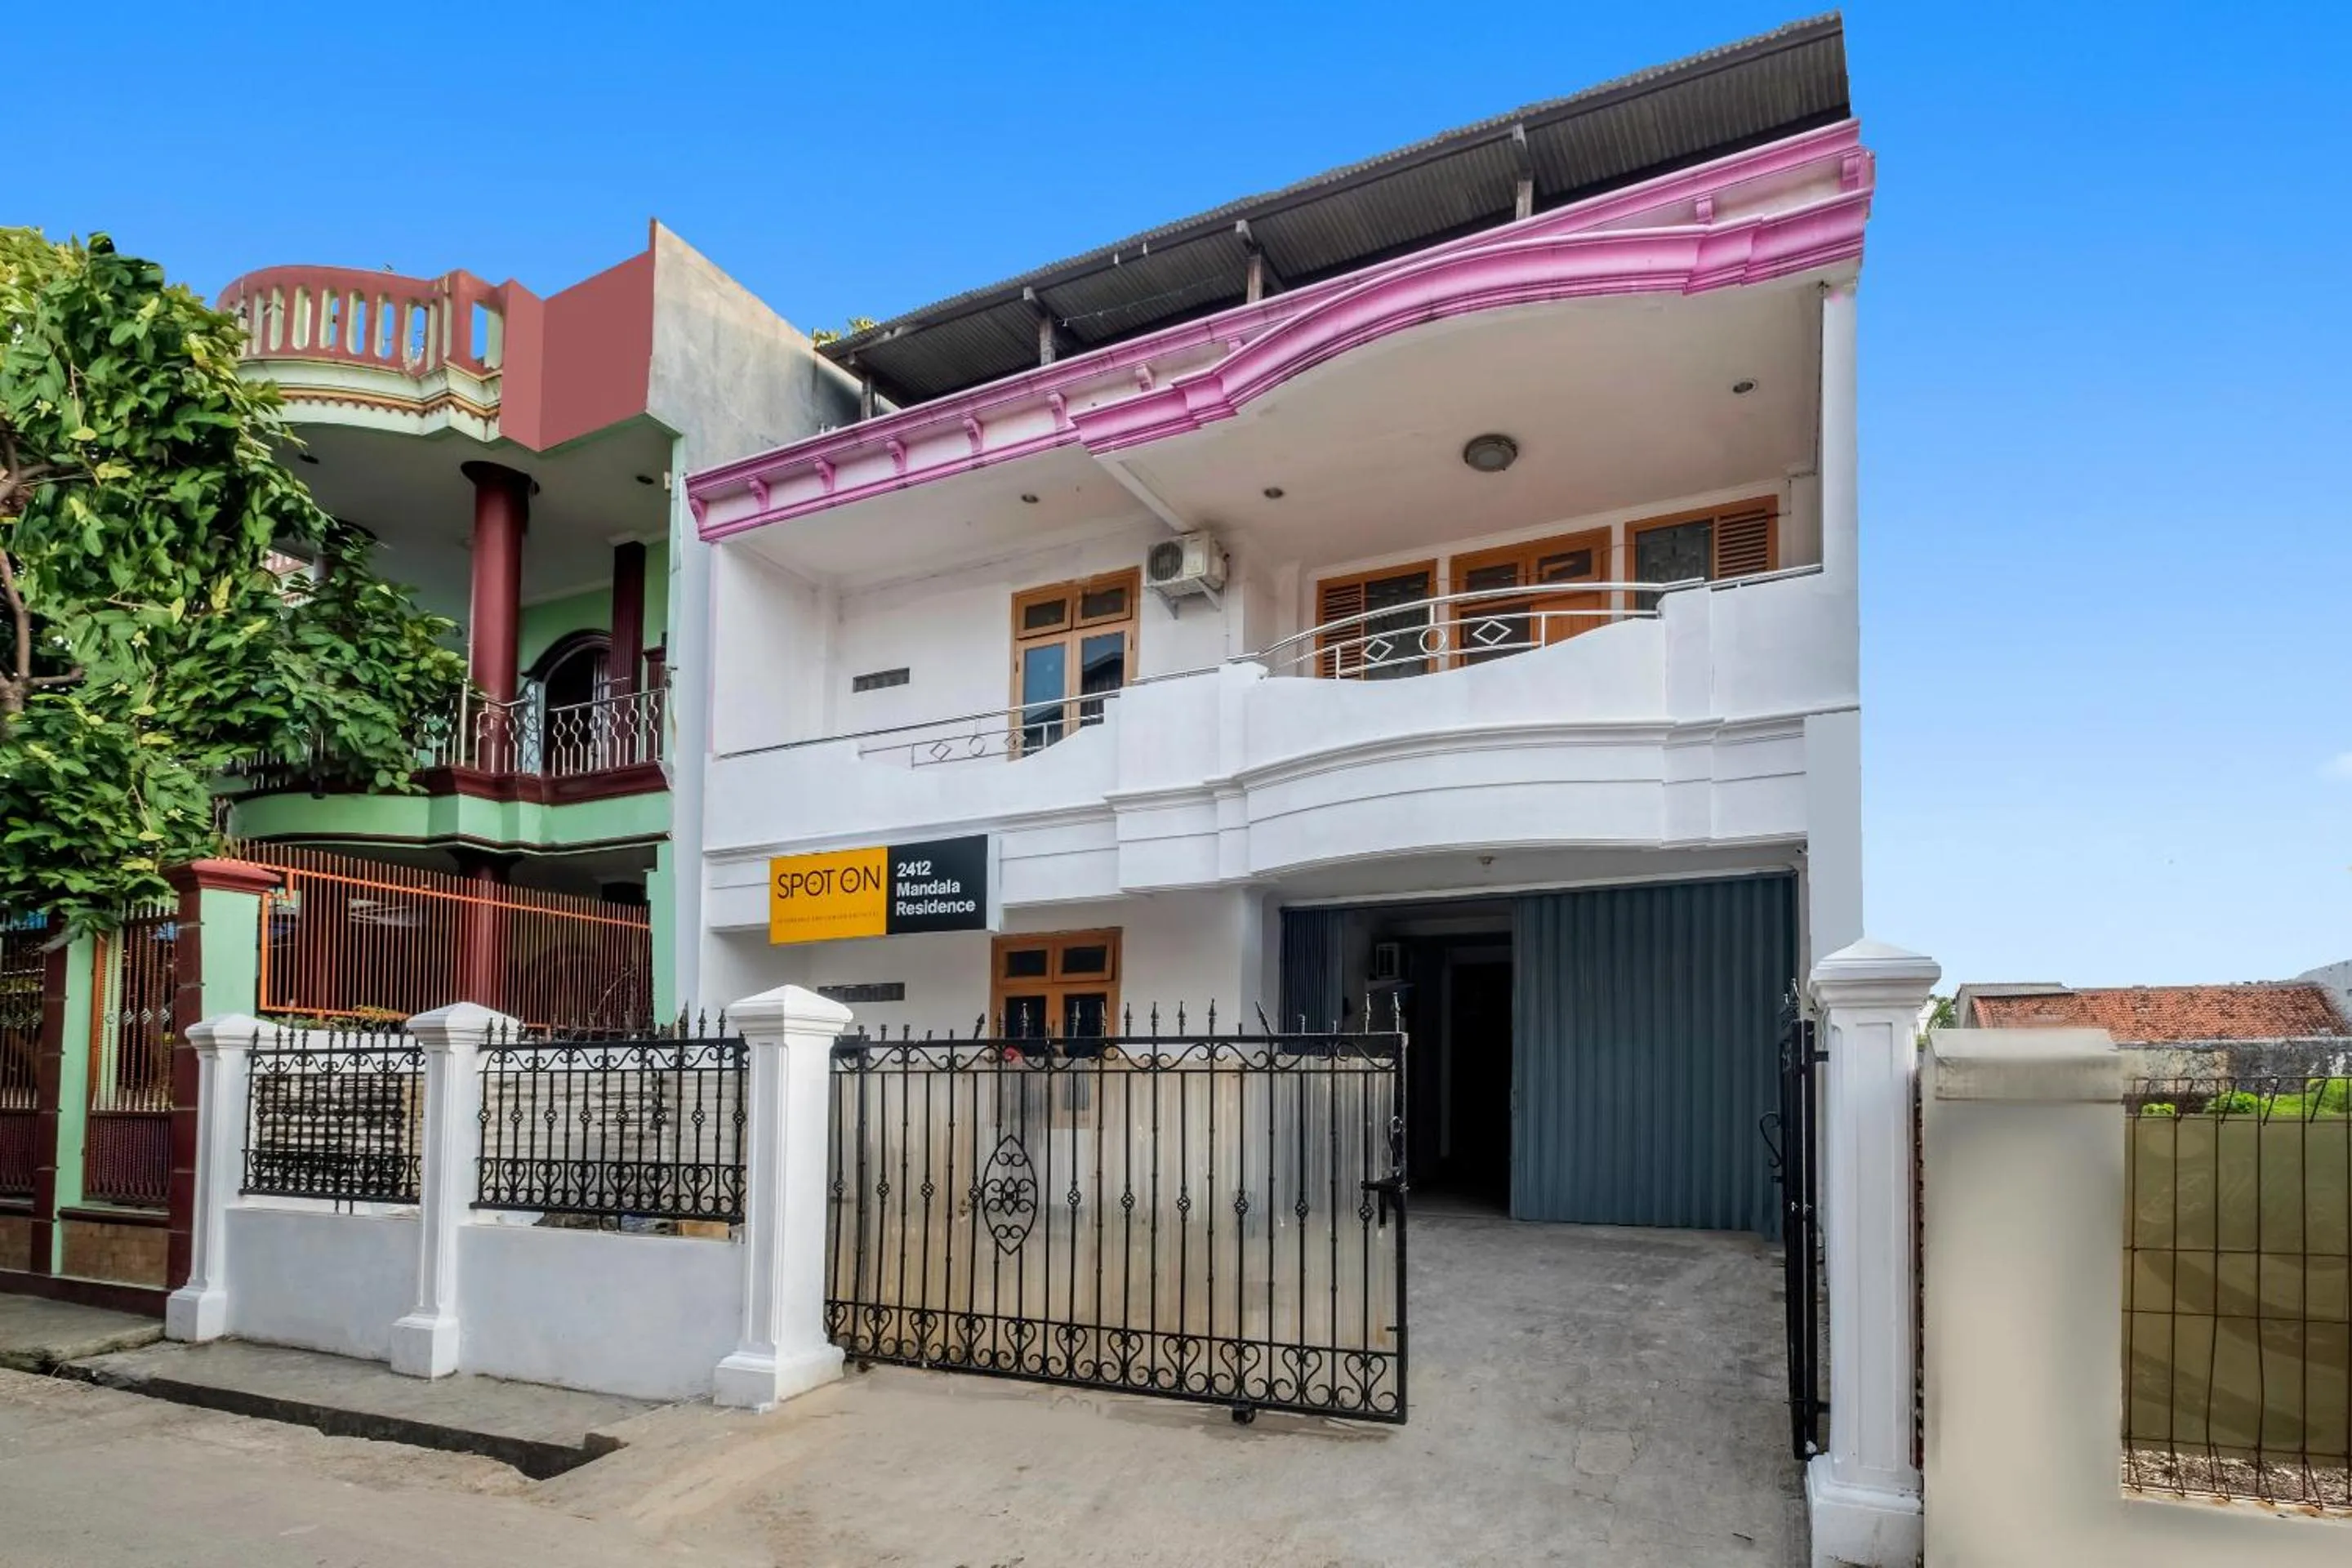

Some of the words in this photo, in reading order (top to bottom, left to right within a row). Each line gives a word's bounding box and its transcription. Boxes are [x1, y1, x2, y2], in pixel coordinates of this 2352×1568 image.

[897, 860, 931, 877] 2412
[777, 868, 836, 899] SPOT
[840, 866, 880, 893] ON
[896, 880, 960, 898] Mandala
[896, 899, 976, 916] Residence
